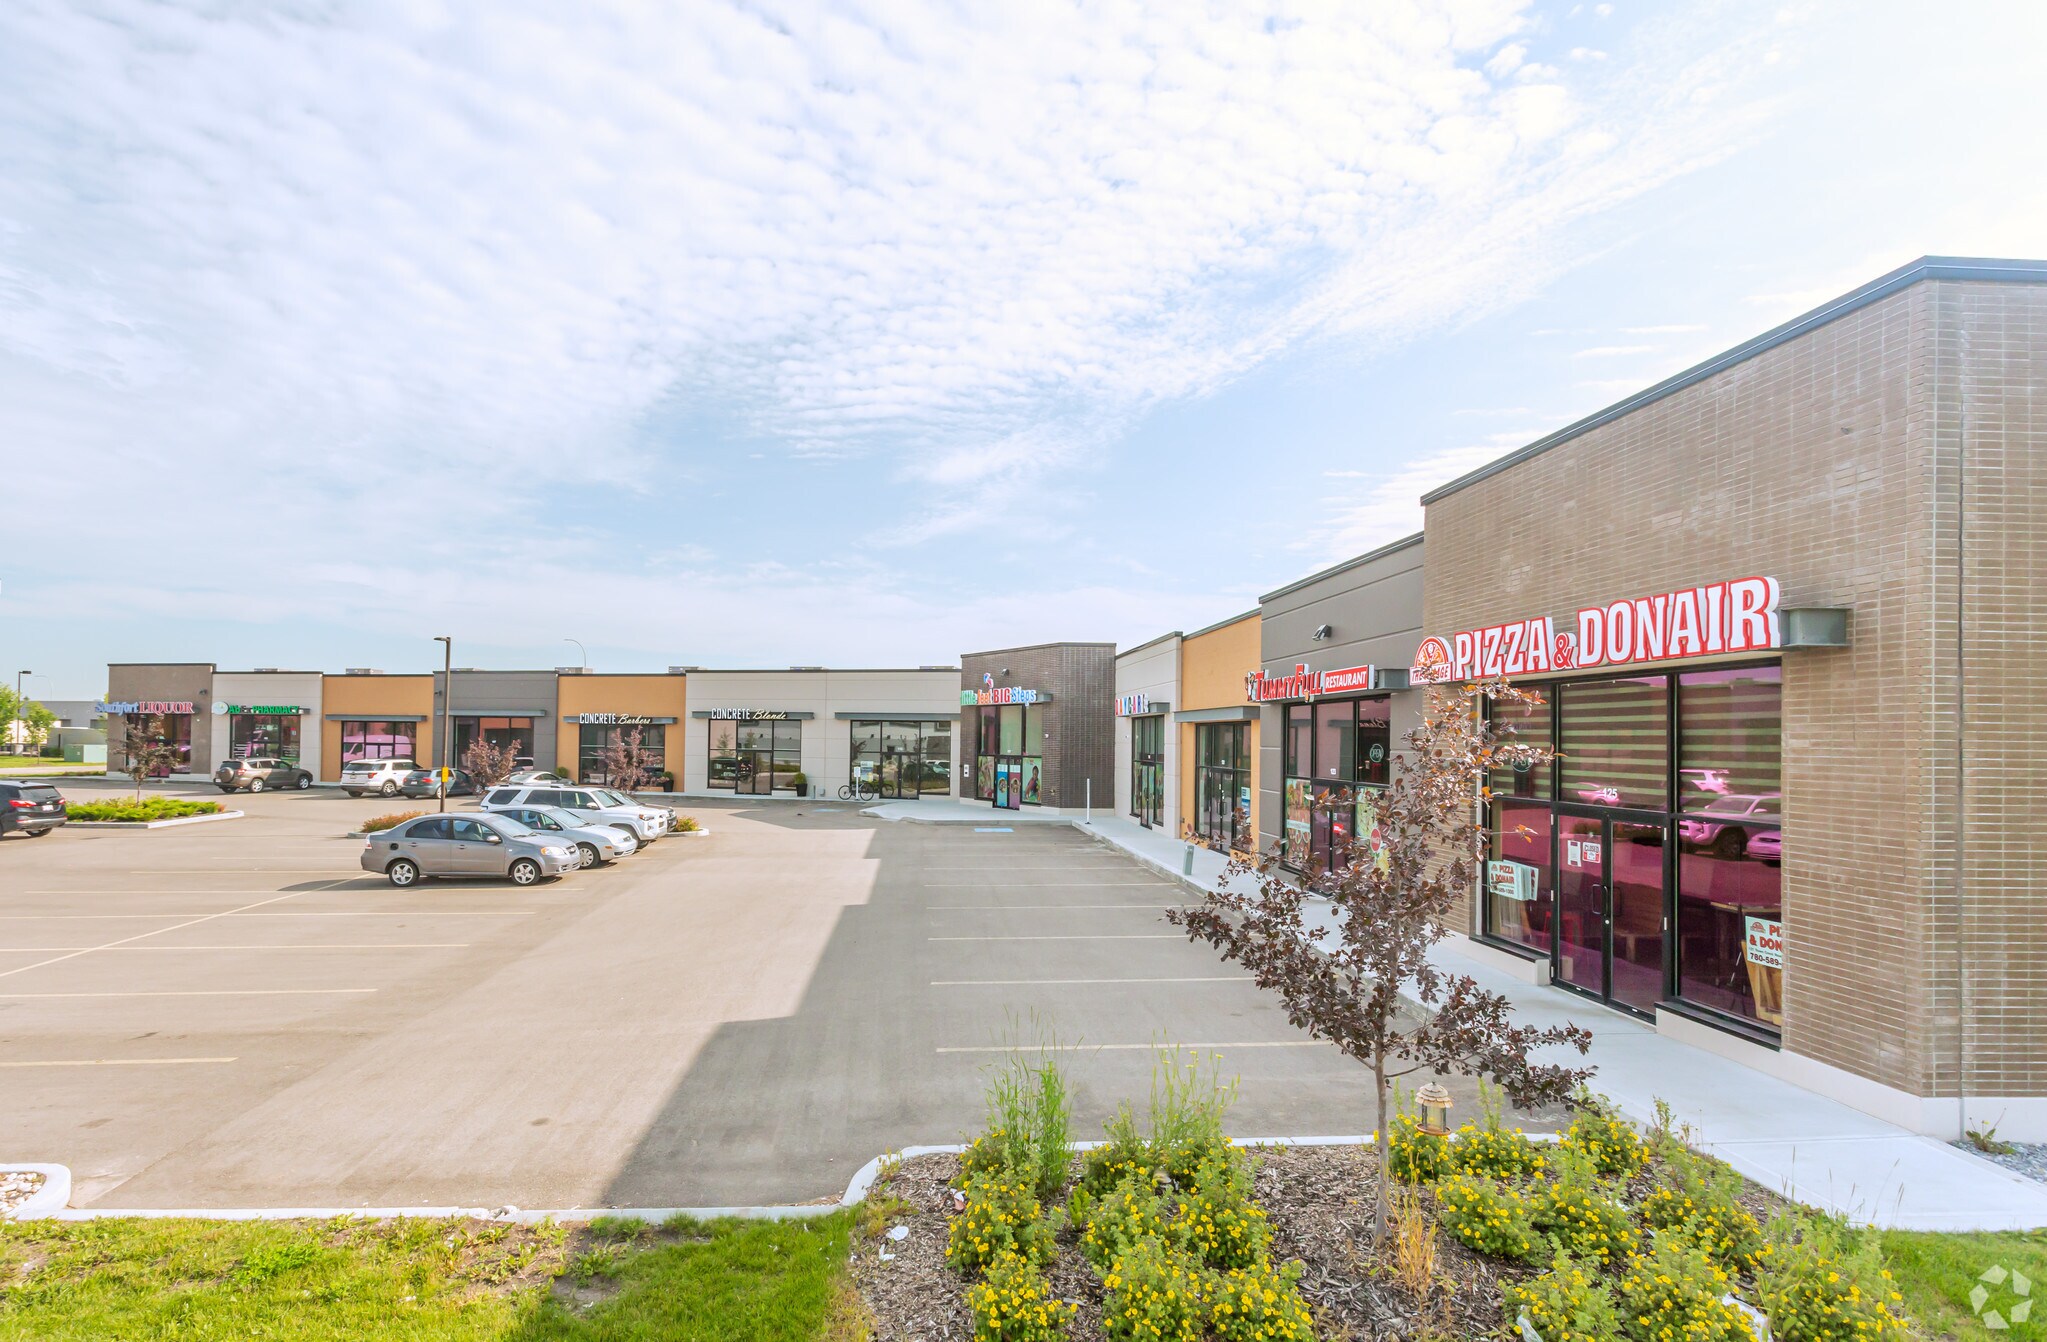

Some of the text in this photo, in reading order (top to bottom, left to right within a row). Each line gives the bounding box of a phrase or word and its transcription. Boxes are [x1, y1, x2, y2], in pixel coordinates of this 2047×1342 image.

[1454, 575, 1771, 681] PIZZA & DONAIR
[1325, 670, 1367, 690] RESTAURANT
[993, 687, 1011, 704] BIG
[1011, 686, 1037, 706] Steps
[139, 701, 195, 716] LIQUOR
[252, 705, 299, 714] PHARMACY
[711, 708, 787, 720] CONCRETE Blonde
[579, 712, 651, 724] CONCRETE Barbers
[1602, 787, 1618, 799] 125
[1584, 844, 1600, 853] CLOSED
[1499, 864, 1515, 875] PIZZA
